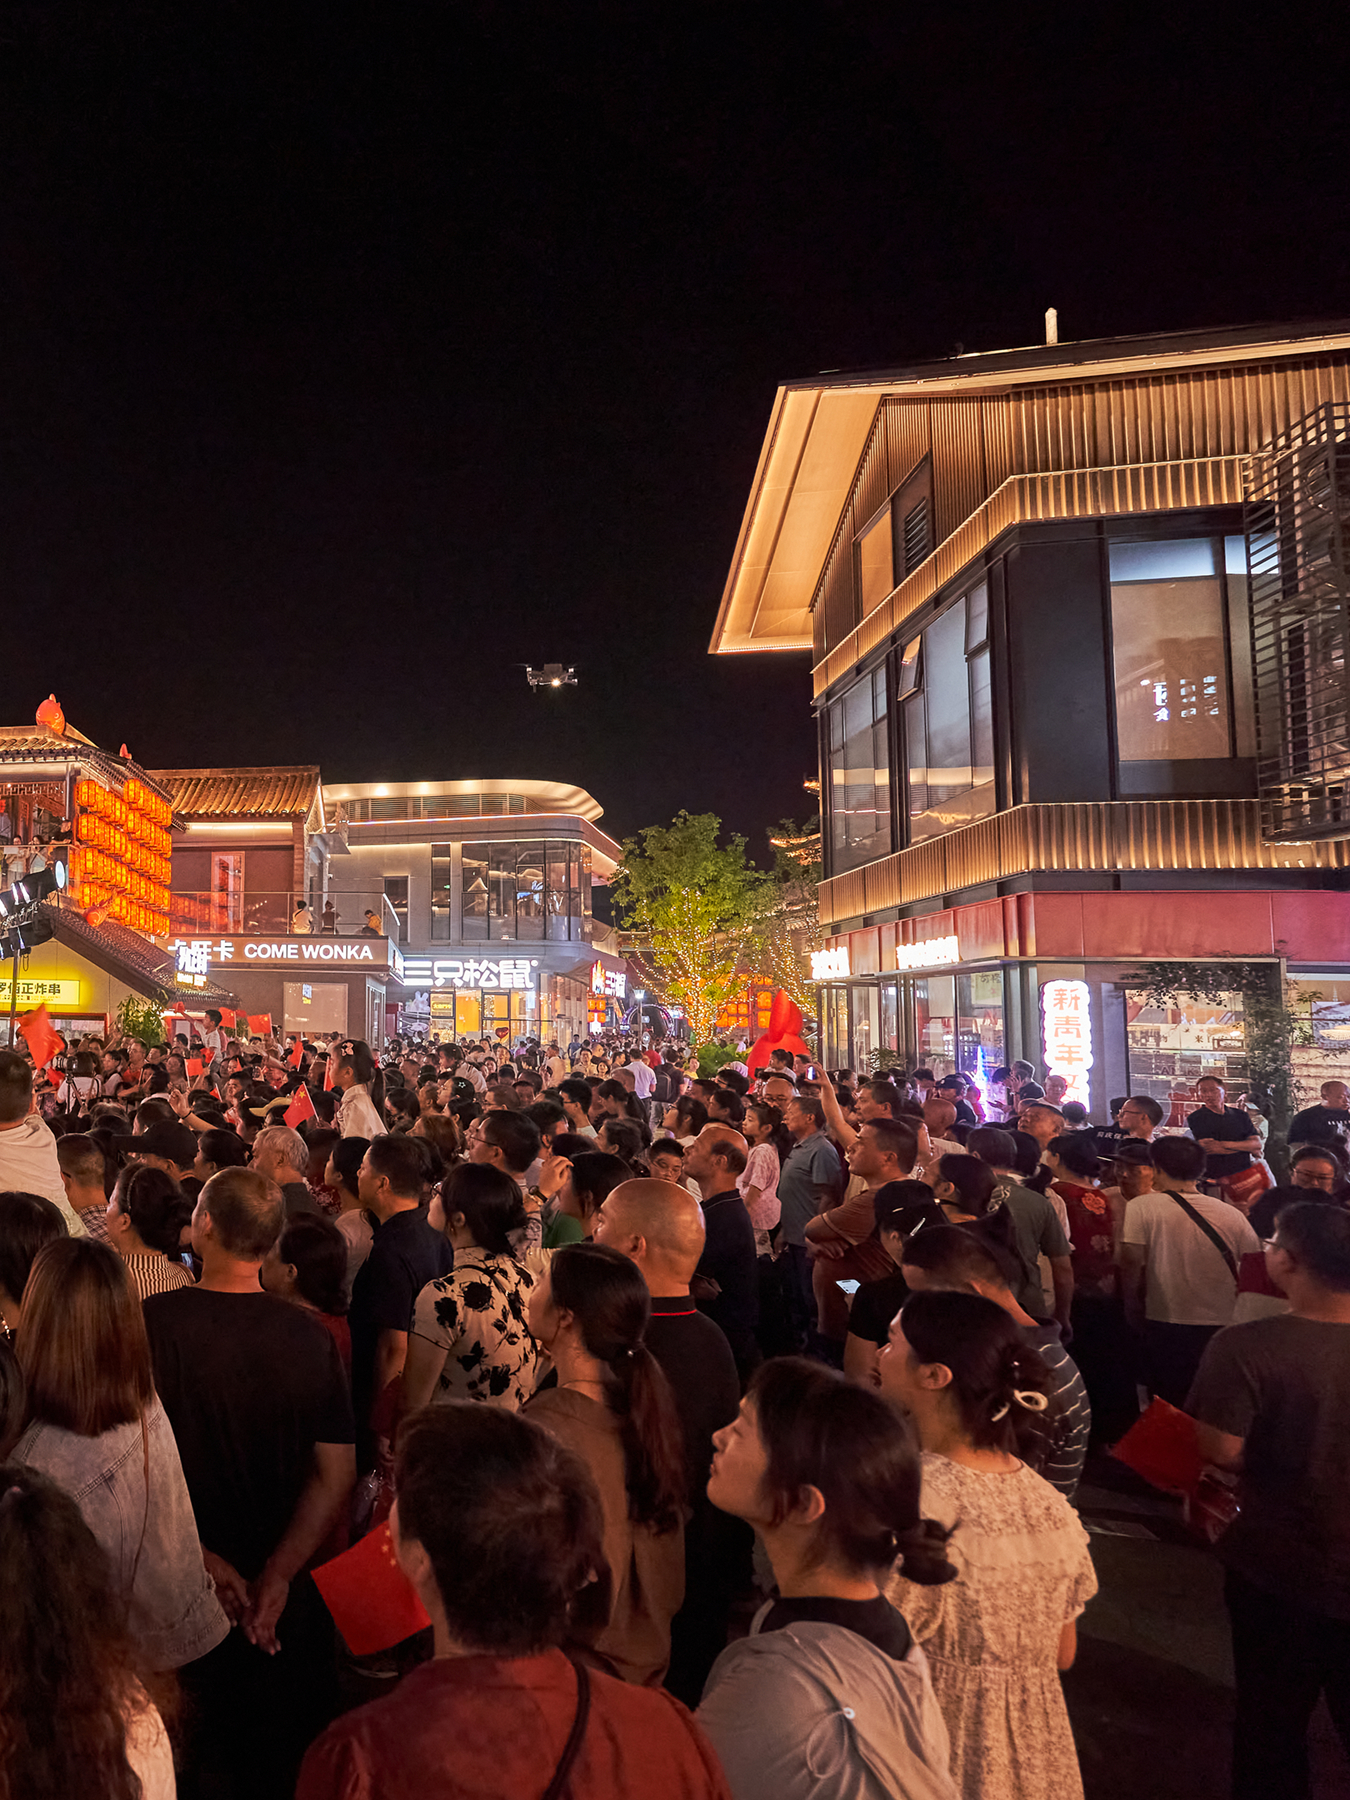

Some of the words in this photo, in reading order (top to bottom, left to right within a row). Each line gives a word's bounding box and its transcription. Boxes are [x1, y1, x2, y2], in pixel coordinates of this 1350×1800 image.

[244, 943, 299, 959] COME
[301, 944, 374, 960] WONKA
[403, 959, 535, 989] 三只松鼠
